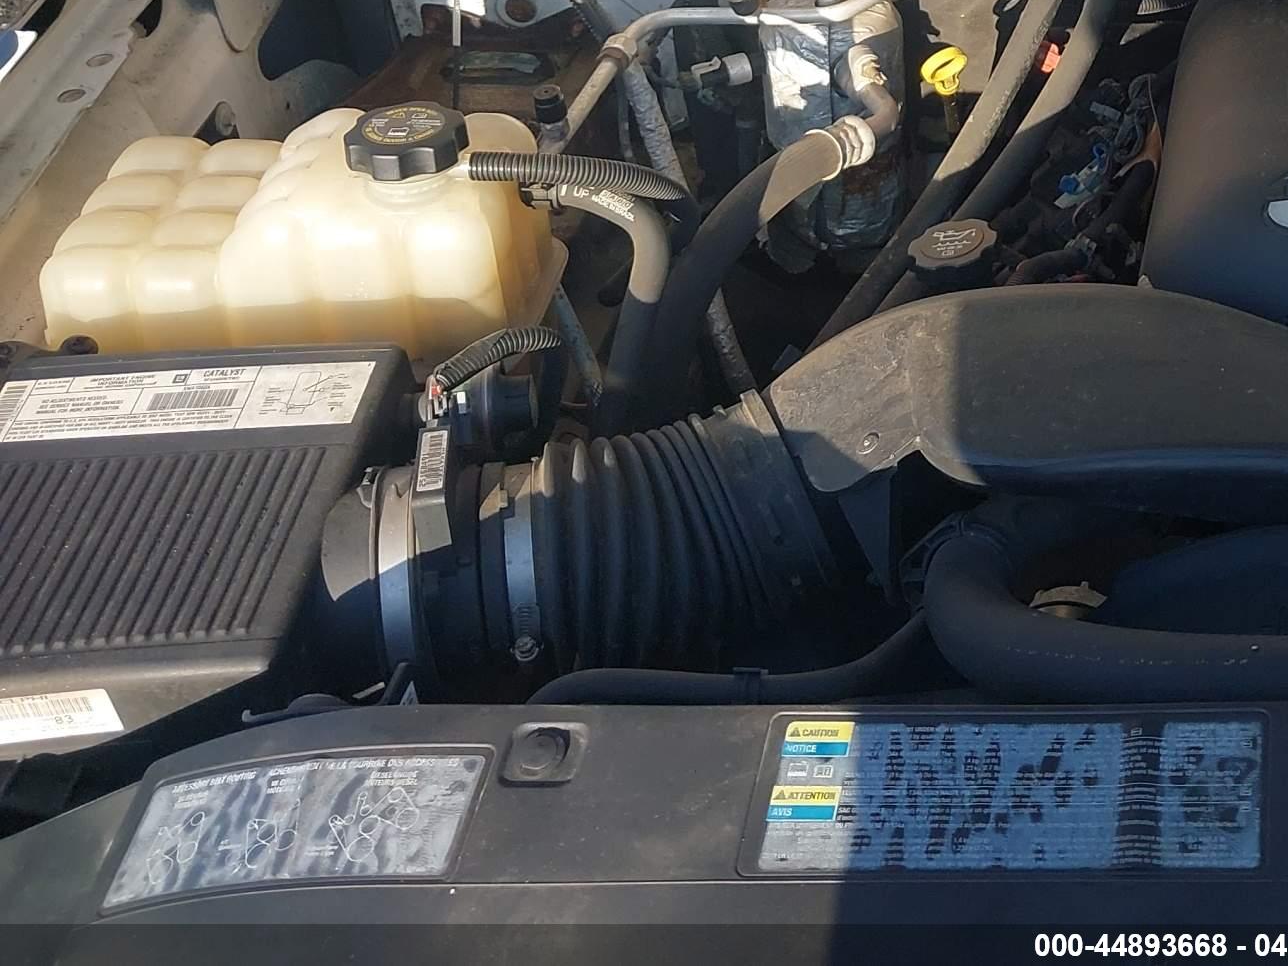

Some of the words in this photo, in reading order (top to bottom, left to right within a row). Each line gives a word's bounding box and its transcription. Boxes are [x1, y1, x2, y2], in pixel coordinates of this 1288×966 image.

[203, 368, 247, 377] CATALYST
[802, 729, 839, 737] CAUTION
[785, 744, 817, 753] NOTICE
[788, 791, 837, 800] ATTENTION
[772, 807, 792, 816] AVIS
